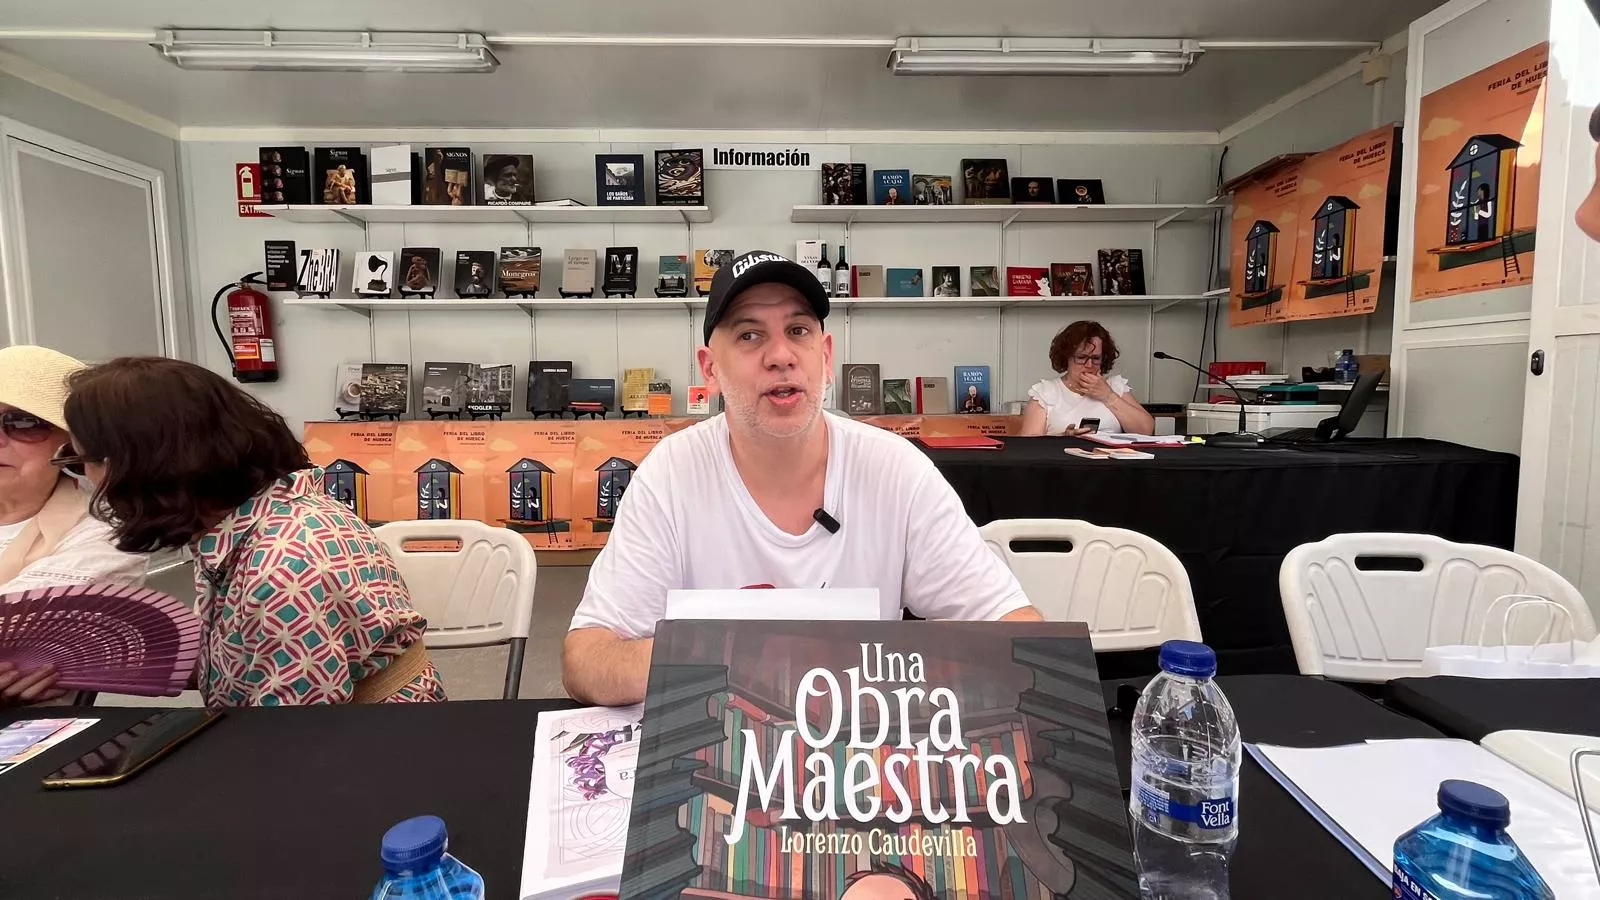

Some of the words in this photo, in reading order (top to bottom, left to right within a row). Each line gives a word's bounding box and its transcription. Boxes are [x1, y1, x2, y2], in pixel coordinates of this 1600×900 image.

[1488, 77, 1511, 91] FERIA
[1515, 69, 1531, 80] DEL
[1534, 61, 1548, 71] LIB
[1511, 81, 1522, 91] DE
[1525, 71, 1547, 85] HUES
[713, 147, 810, 166] Información
[501, 270, 537, 278] Monegros
[859, 642, 926, 684] Una
[794, 666, 968, 752] Obra
[723, 727, 1028, 845] Maestra
[1202, 801, 1230, 815] Font
[1201, 813, 1231, 827] Vella
[780, 826, 864, 856] Lorenzo
[868, 826, 978, 857] Caudevilla
[1410, 881, 1421, 897] EN
